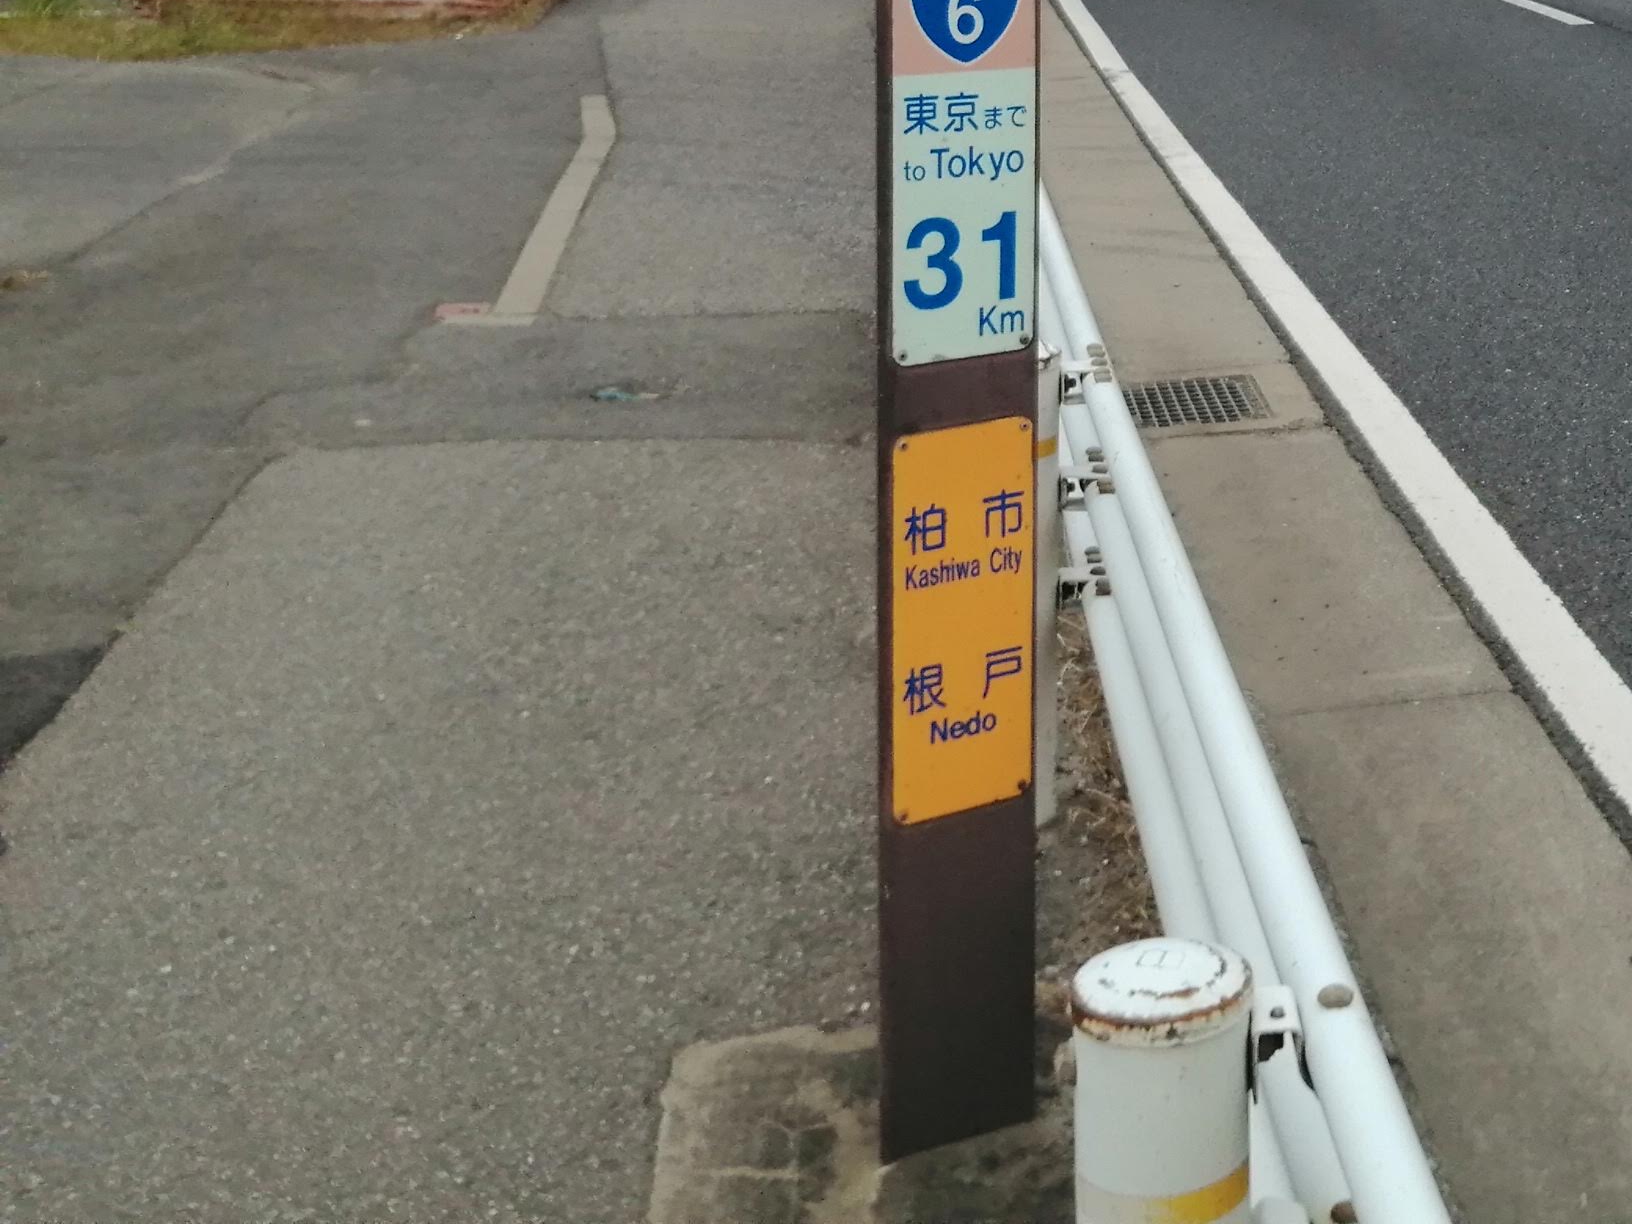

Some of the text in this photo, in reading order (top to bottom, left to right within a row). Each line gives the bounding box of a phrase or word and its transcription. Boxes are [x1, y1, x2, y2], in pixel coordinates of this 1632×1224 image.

[902, 91, 1028, 136] 東京まで
[903, 146, 1025, 182] to Tokyo
[903, 210, 1018, 311] 31
[978, 304, 1026, 338] Km
[904, 546, 1023, 591] Kashiwa City
[930, 709, 997, 745] Nedo
